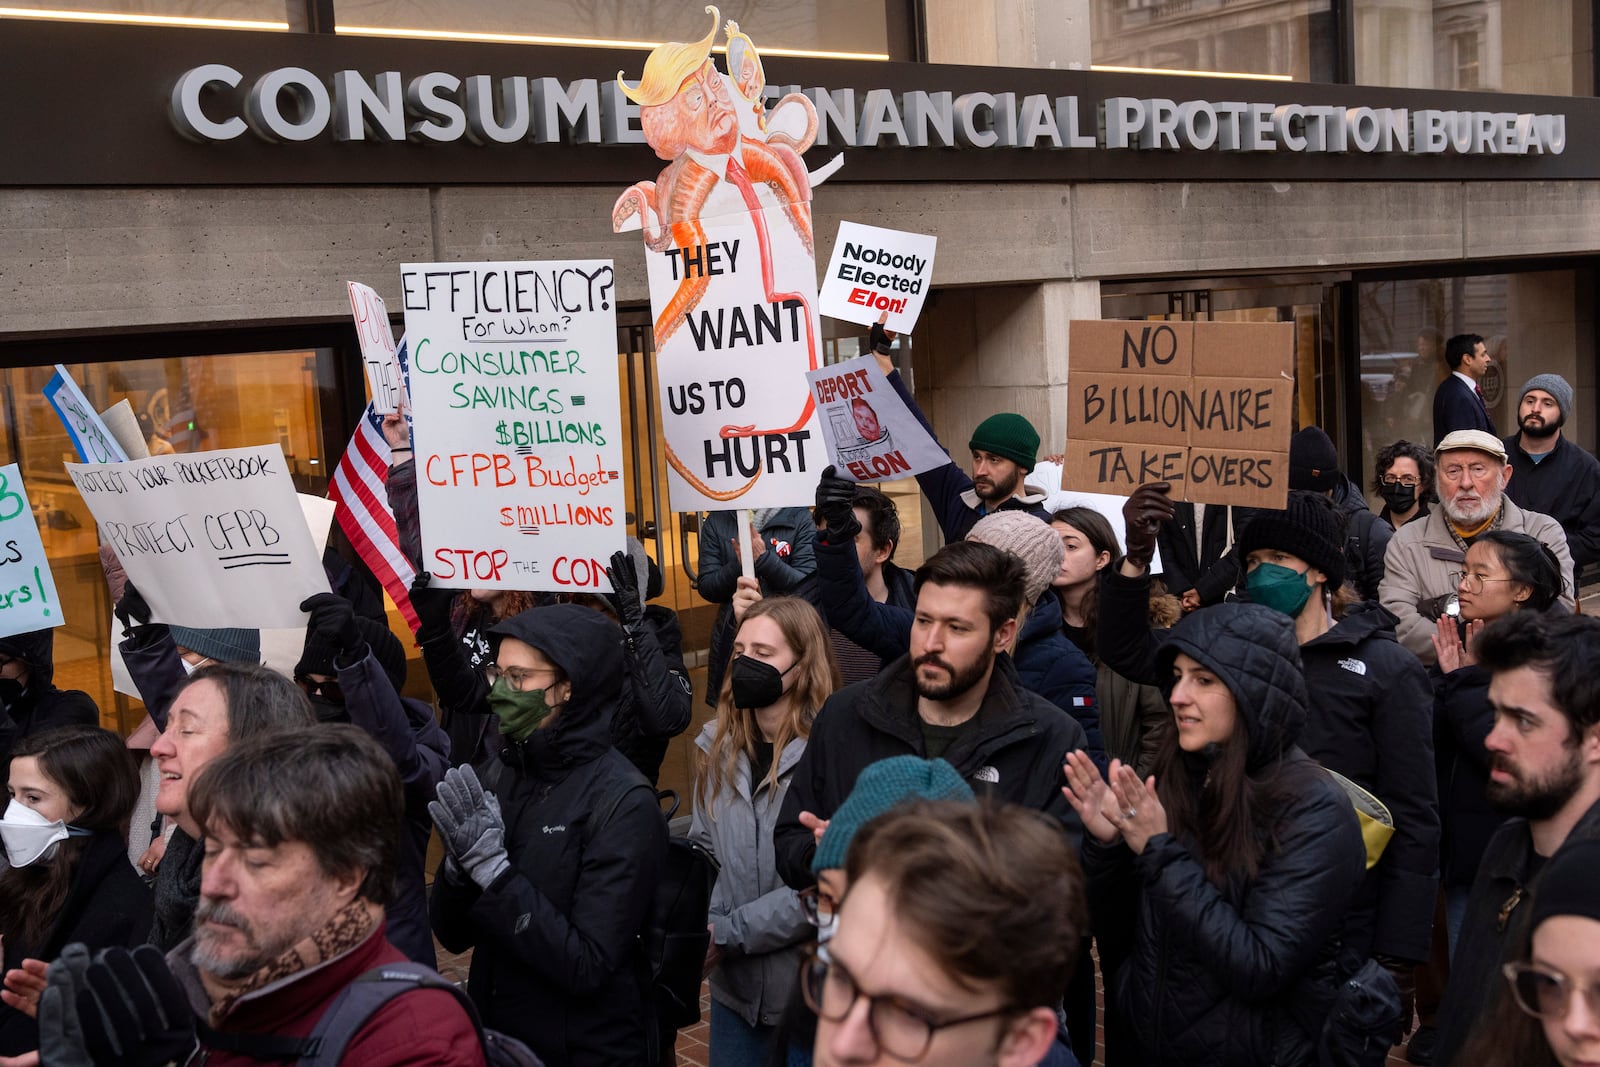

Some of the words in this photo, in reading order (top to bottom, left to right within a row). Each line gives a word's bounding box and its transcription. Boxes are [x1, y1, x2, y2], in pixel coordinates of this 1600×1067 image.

[172, 62, 643, 145] CONSUME
[1107, 97, 1410, 154] PROTECTION
[1412, 109, 1566, 156] BUREAU
[665, 240, 739, 281] THEY
[842, 243, 926, 274] Nobody
[402, 265, 614, 313] EFFICIENCY?
[837, 264, 922, 295] Elected
[848, 288, 907, 314] Elon!
[462, 316, 495, 341] For
[503, 316, 571, 335] Whom?
[686, 299, 803, 352] WANT
[415, 338, 587, 376] CONSUMER
[1121, 325, 1178, 368] NO
[450, 382, 564, 414] SAVINGS
[668, 382, 705, 415] US
[709, 377, 746, 410] TO
[815, 368, 873, 405] DEPORT
[1084, 384, 1273, 432] BILLIONAIRE
[495, 420, 607, 447] $BILLIONS
[425, 453, 517, 488] CFPB
[703, 430, 811, 478] HURT
[846, 450, 912, 480] ELON
[71, 470, 129, 494] PROTECT
[129, 465, 174, 491] YOUR
[105, 514, 195, 557] PROTECT
[204, 509, 281, 551] CFPB
[432, 547, 508, 581] STOP
[512, 560, 541, 575] THE
